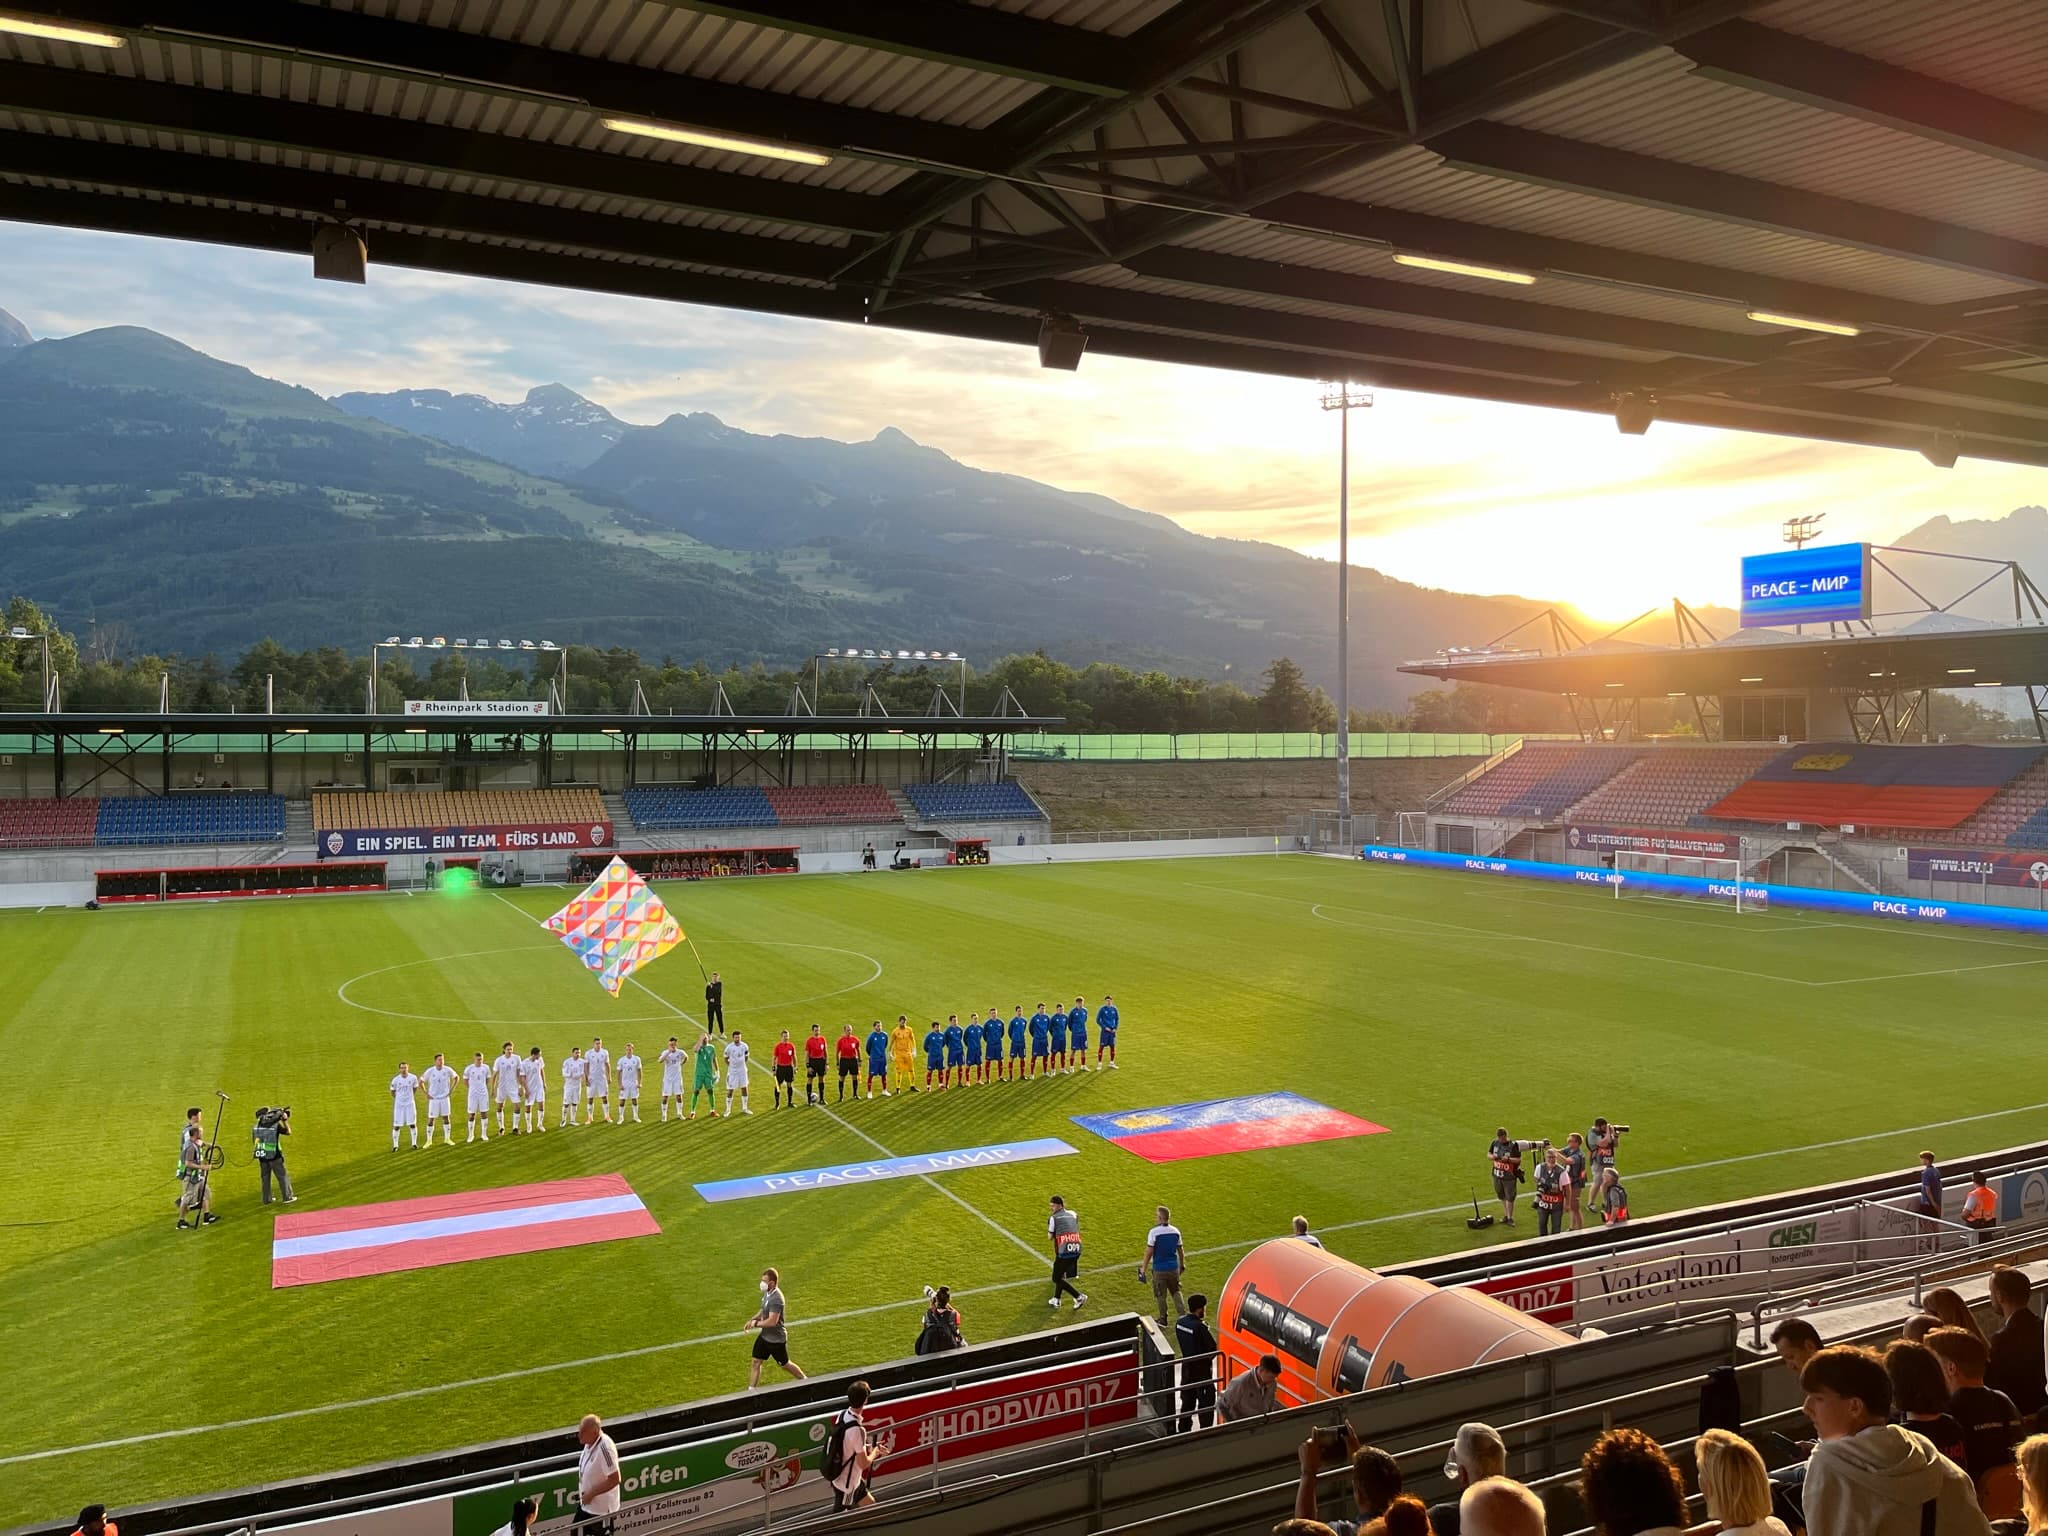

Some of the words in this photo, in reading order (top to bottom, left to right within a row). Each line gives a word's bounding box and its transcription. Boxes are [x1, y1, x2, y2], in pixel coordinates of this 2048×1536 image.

[1751, 580, 1797, 598] PEACE
[1812, 575, 1849, 592] МИР
[425, 703, 482, 714] Rheinpark
[487, 703, 529, 712] Stadion
[356, 837, 380, 851] EIN
[384, 835, 428, 850] SPIEL.
[432, 834, 456, 849] EIN
[459, 833, 500, 848] TEAM.
[505, 831, 538, 846] FÜRS
[542, 832, 579, 846] LAND.
[1371, 850, 1388, 859] PEACE
[1465, 860, 1485, 869] PEACE
[1576, 871, 1599, 882] PEACE
[1709, 884, 1737, 896] PEACE
[1745, 888, 1767, 899] МИР
[1873, 900, 1908, 914] PEACE
[1918, 905, 1946, 918] МИР
[763, 1165, 893, 1190] PEACE
[929, 1149, 1012, 1168] МИР
[1596, 1239, 1741, 1306] Vaterland
[731, 1444, 770, 1460] PIZZERIA
[738, 1452, 768, 1467] TOSCANA
[624, 1464, 688, 1492] offen
[656, 1495, 701, 1511] Zollstrasse
[703, 1490, 715, 1499] 82
